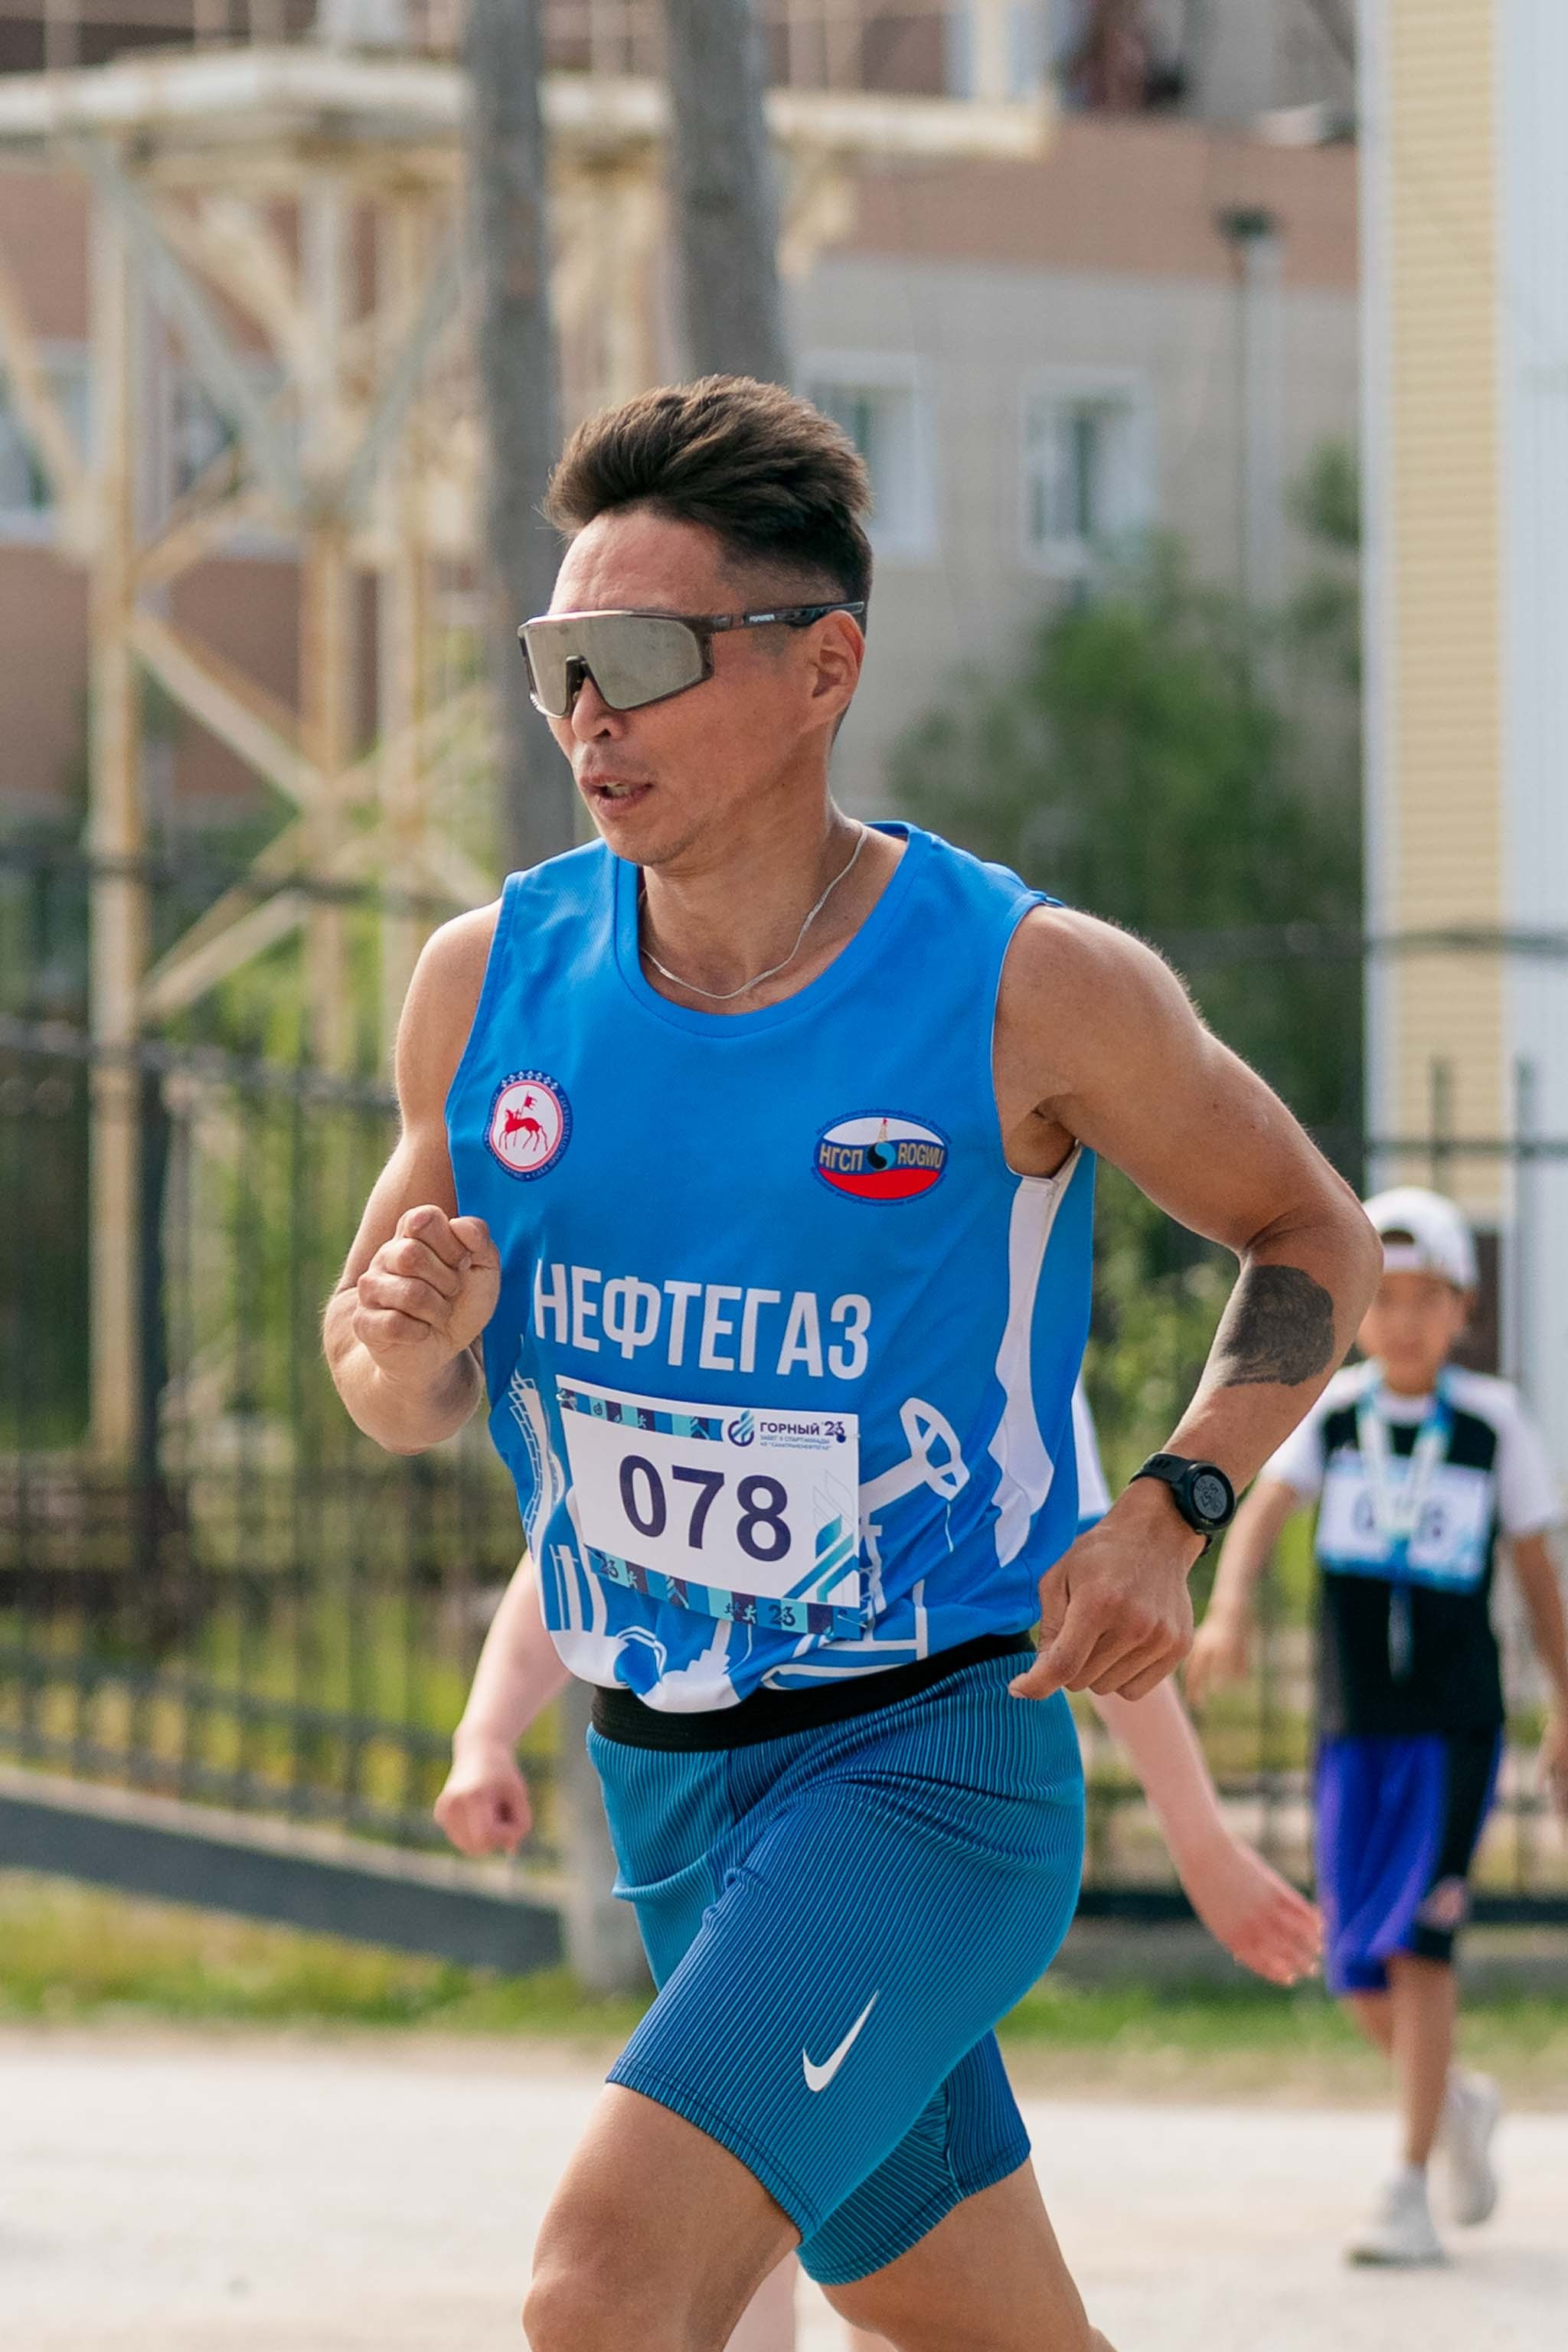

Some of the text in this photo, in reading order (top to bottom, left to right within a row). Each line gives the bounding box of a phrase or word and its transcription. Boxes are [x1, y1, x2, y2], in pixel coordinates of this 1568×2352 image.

[819, 1143, 864, 1172] НГСП
[534, 1259, 871, 1380] НЕФТЕГАЗ
[760, 1421, 819, 1436] ГОРНЫЙ
[619, 1455, 792, 1562] 078
[768, 1604, 795, 1627] 23
